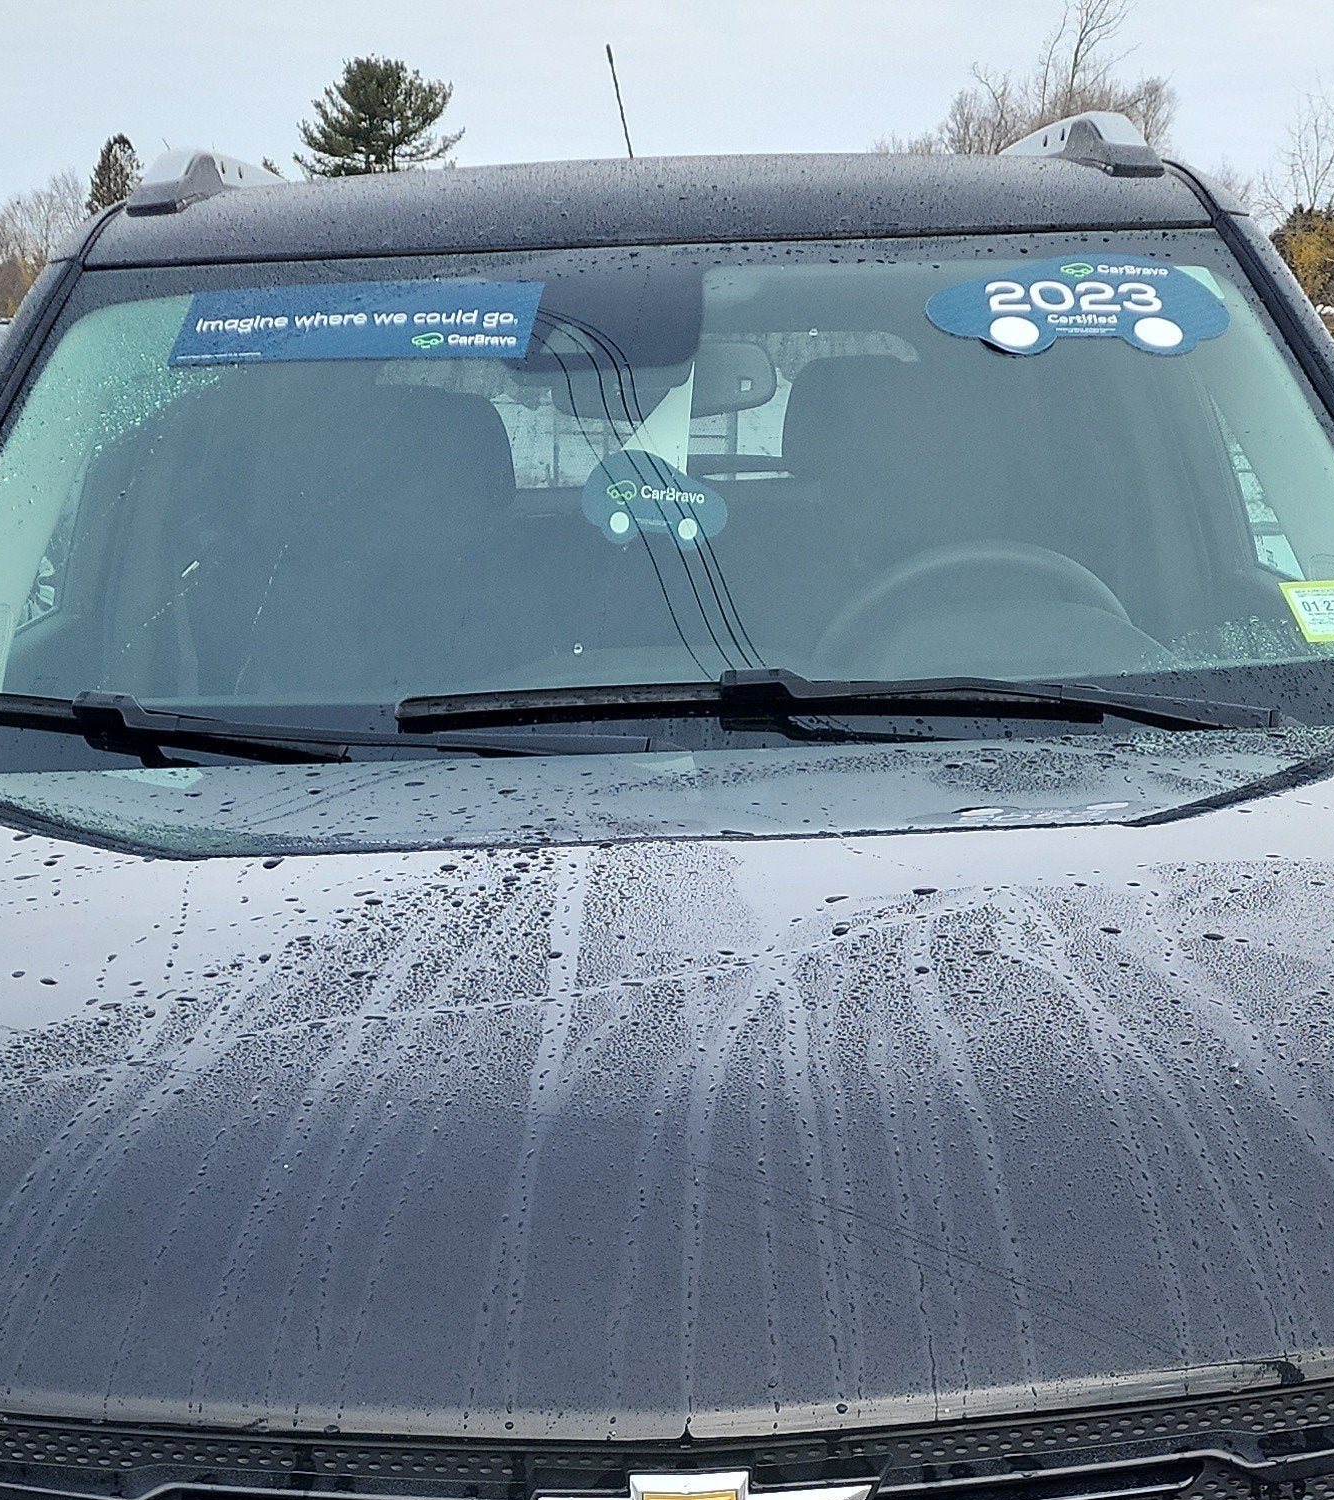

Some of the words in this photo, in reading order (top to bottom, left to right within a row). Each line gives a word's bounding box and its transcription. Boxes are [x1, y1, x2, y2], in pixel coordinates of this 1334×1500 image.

[1097, 264, 1169, 277] CarBravo
[985, 280, 1163, 312] 2023
[196, 315, 289, 334] Imagine
[294, 312, 367, 328] where
[373, 312, 408, 326] we
[414, 309, 479, 325] could
[1047, 314, 1118, 325] Certified
[447, 334, 517, 346] CarBravo
[640, 485, 705, 504] CarBravo
[1301, 601, 1319, 612] 01
